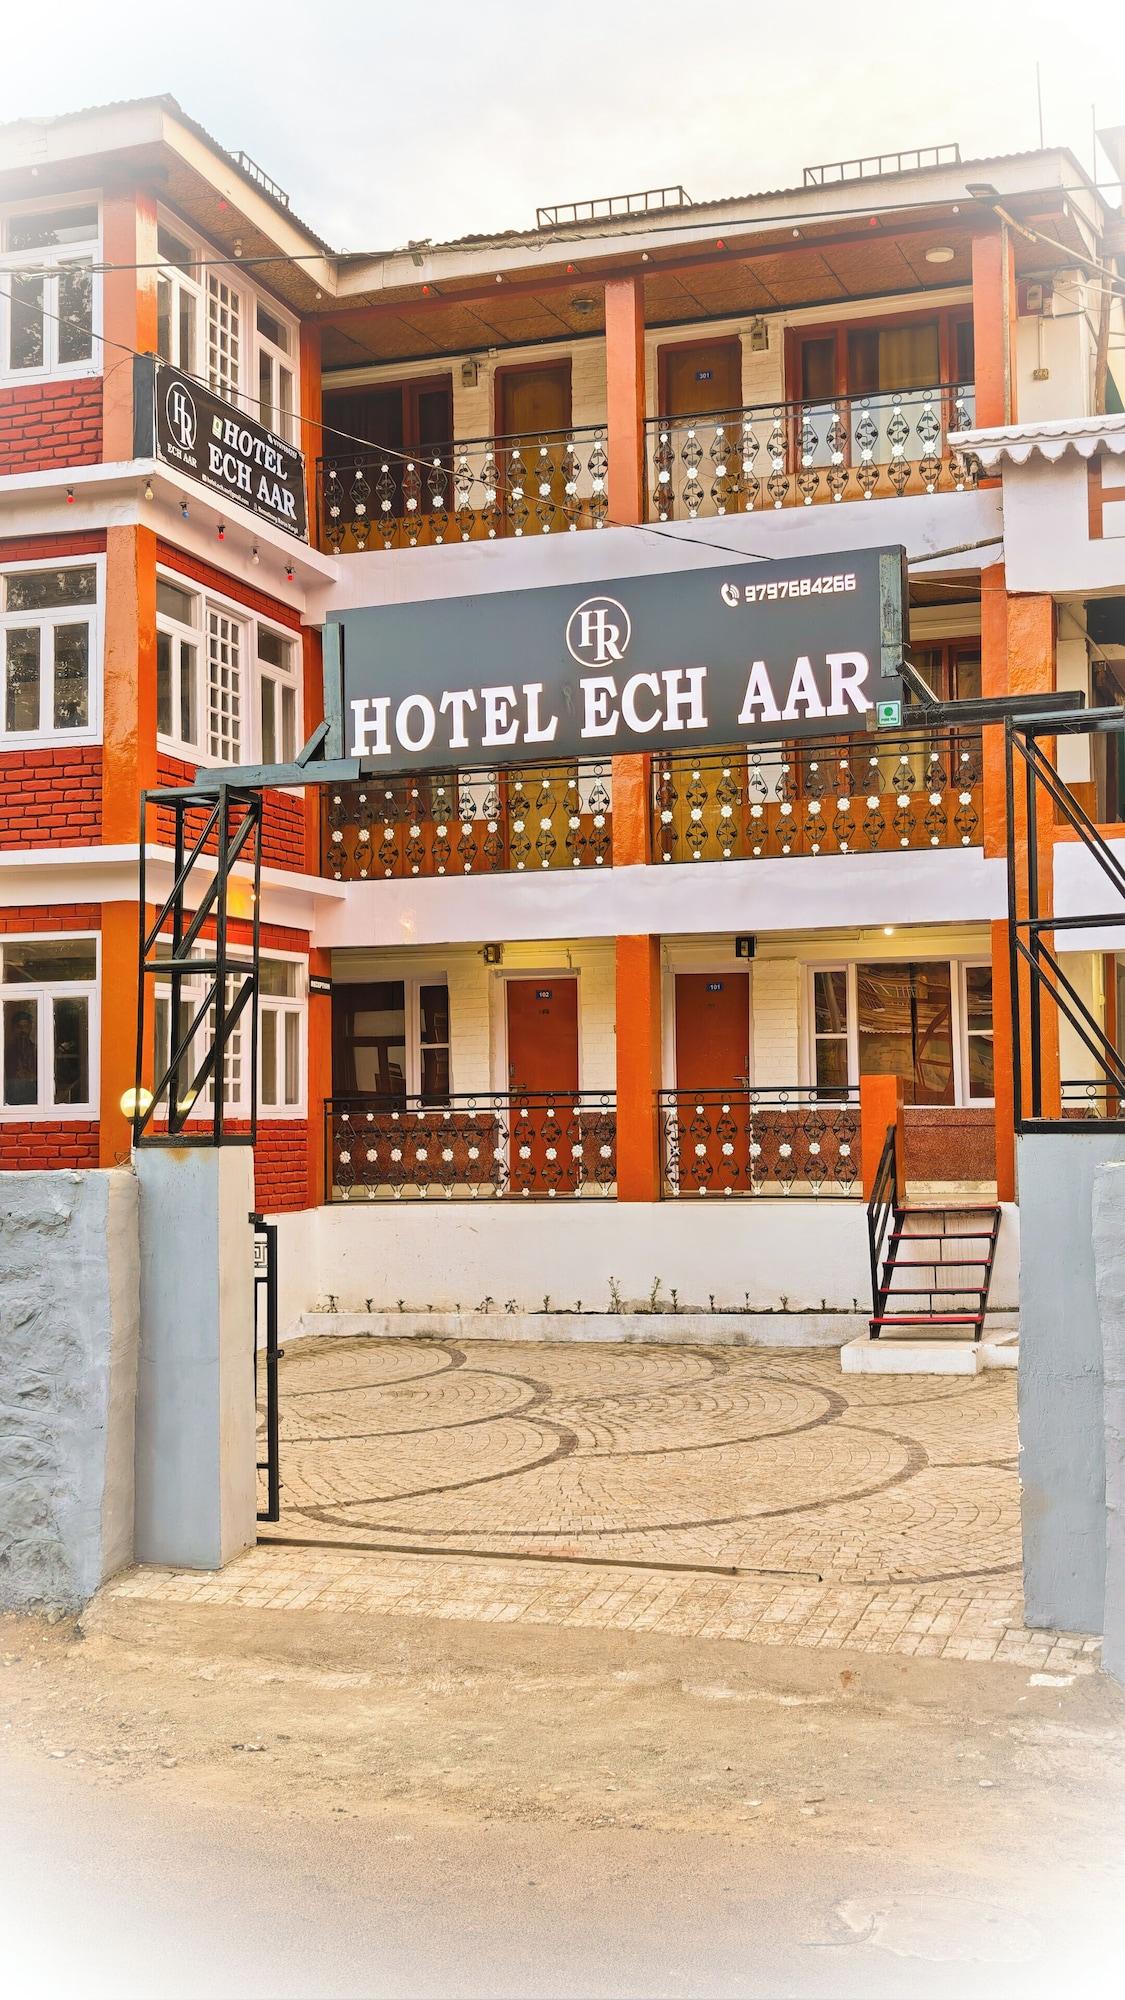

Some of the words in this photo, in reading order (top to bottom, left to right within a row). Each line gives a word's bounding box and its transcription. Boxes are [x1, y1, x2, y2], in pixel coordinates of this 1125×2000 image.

[167, 442, 182, 460] ECH
[183, 453, 198, 468] AAR
[223, 418, 288, 480] HOTEL
[207, 442, 252, 494] ECH
[256, 475, 297, 520] AAR
[745, 573, 856, 602] 9797684266
[350, 683, 558, 757] HOTEL
[579, 667, 708, 738] ECH
[737, 651, 873, 724] AAR
